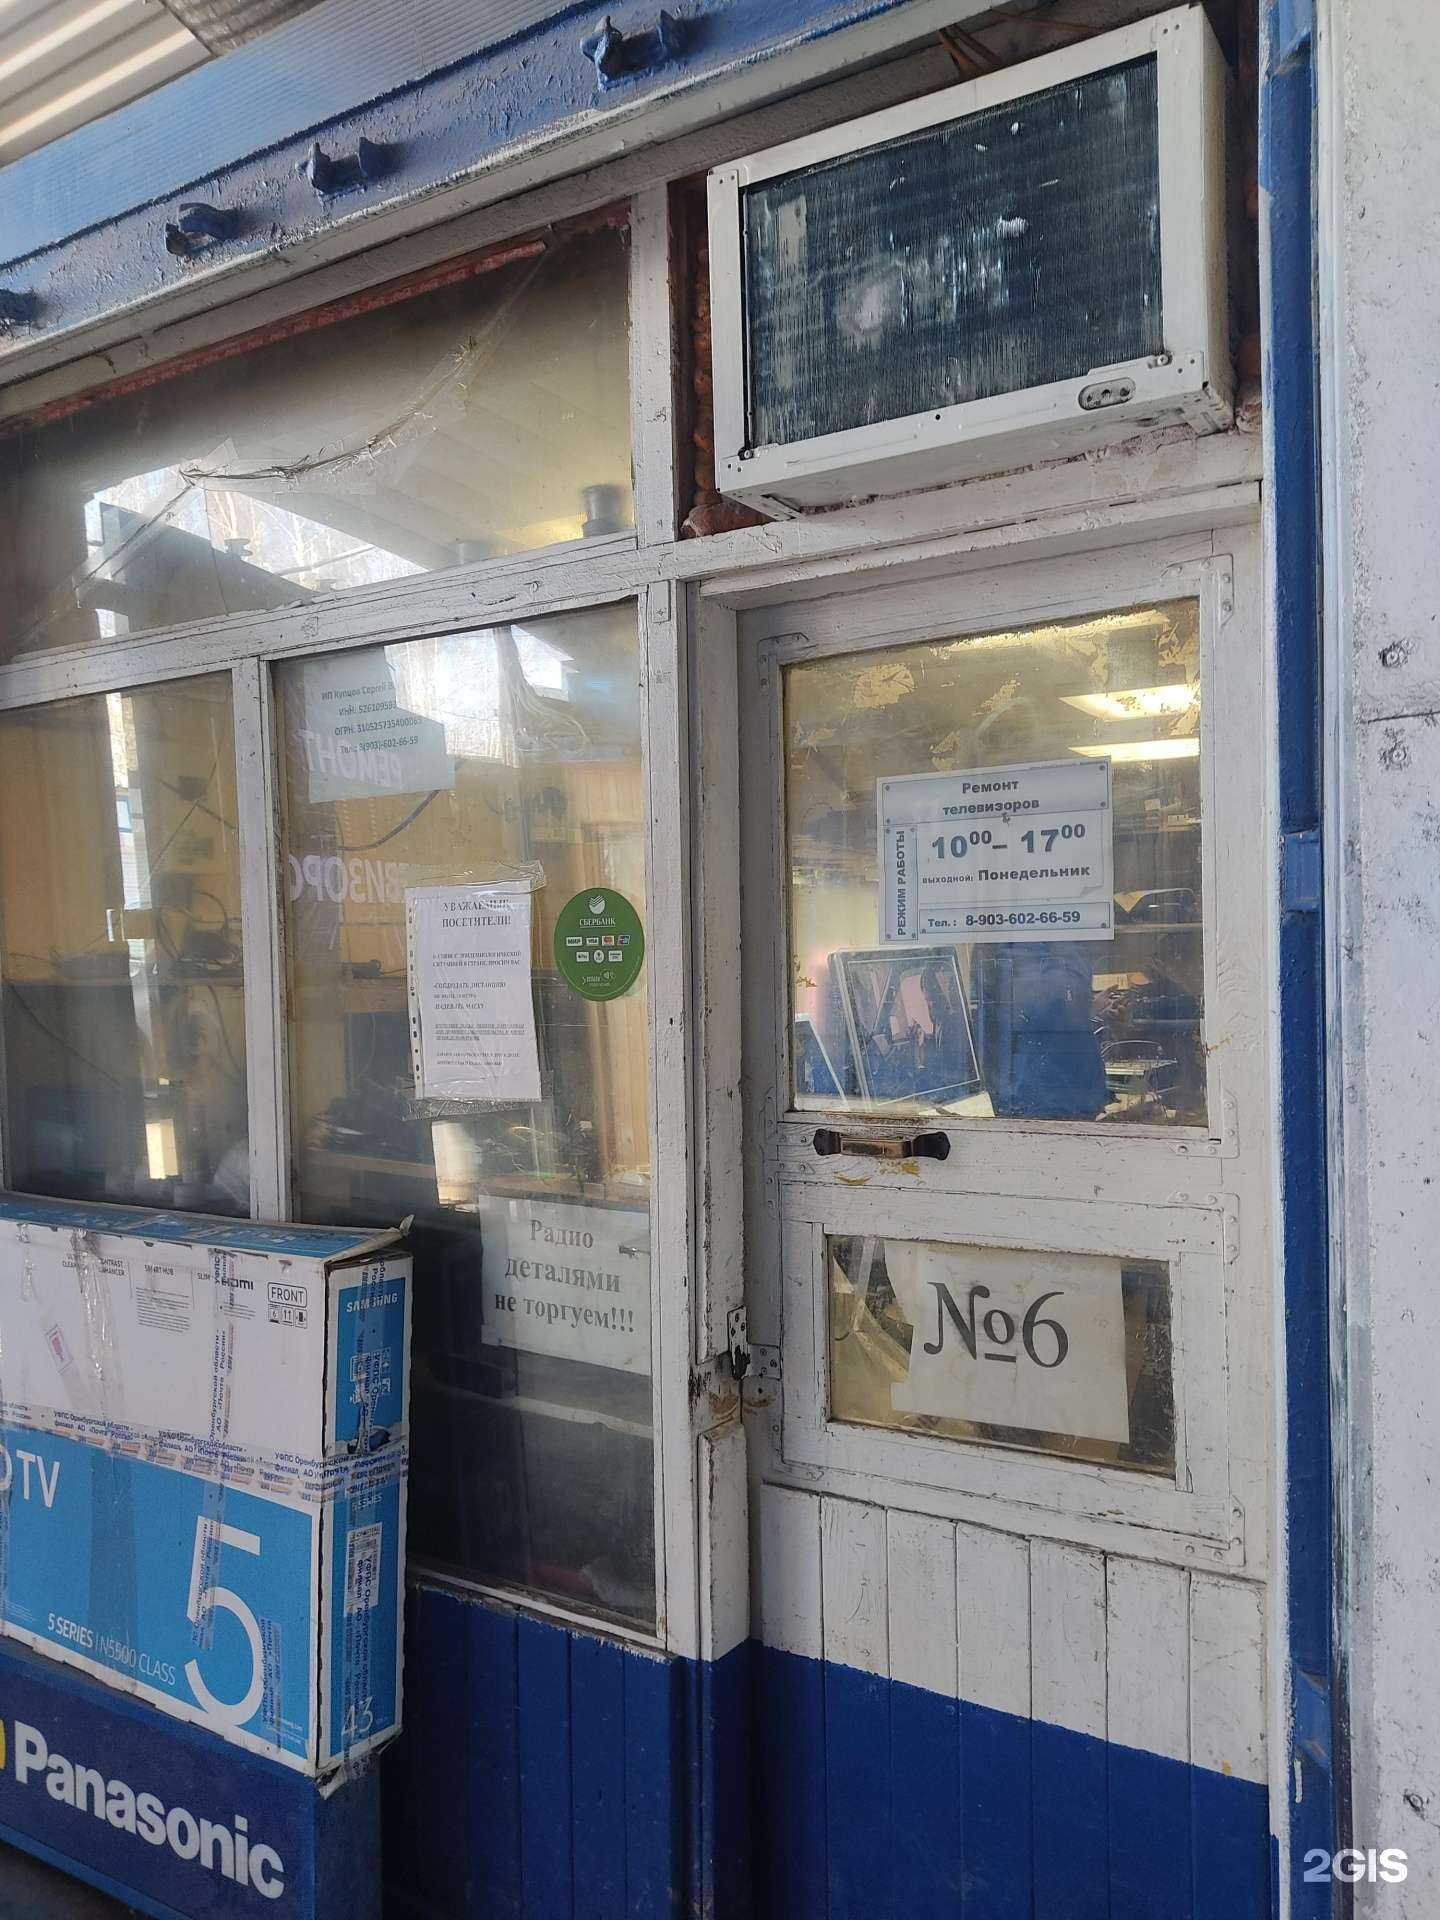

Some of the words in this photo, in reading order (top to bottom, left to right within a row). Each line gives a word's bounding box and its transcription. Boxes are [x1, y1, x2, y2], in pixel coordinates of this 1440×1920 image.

[961, 780, 1019, 794] Ремонт
[942, 799, 1040, 816] телевизоров
[896, 830, 906, 885] РАБОТЫ
[977, 864, 1091, 882] Понедельник
[442, 915, 512, 928] ПОСЕТИТЕЛИ!
[443, 899, 512, 912] УВАЖАЕ
[579, 917, 616, 926] СБЕРБАНК
[897, 888, 906, 936] РЕЖИМ
[965, 910, 1081, 927] 8-903-602-66-59
[530, 1219, 594, 1249] Радио
[504, 1256, 622, 1293] деталями
[270, 1286, 304, 1304] FRONT
[494, 1293, 518, 1312] не
[522, 1297, 634, 1333] торгуем!!!
[923, 1281, 1069, 1369] №6
[185, 1515, 265, 1727] 5
[47, 1612, 55, 1631] 5
[55, 1616, 94, 1649] SERIES
[100, 1634, 137, 1669] N5500
[138, 1652, 176, 1686] CLASS
[341, 1695, 373, 1740] 43
[14, 1720, 285, 1900] Panasonic
